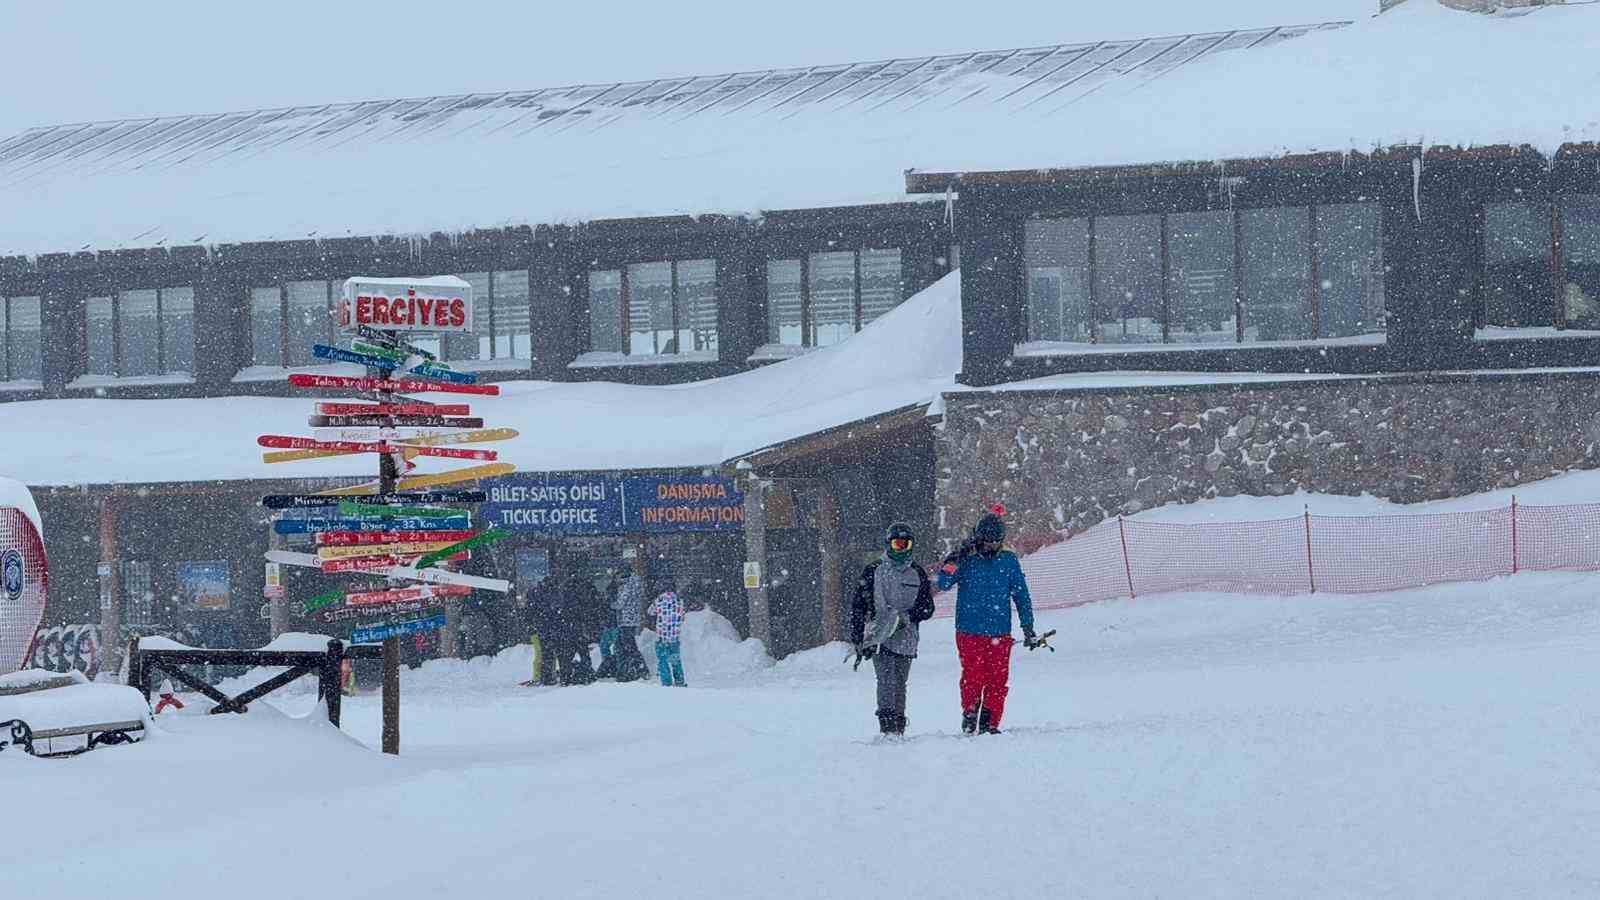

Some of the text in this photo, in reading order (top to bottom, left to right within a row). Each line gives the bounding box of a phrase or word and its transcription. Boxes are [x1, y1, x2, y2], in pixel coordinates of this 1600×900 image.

[356, 289, 466, 327] ERCİYES
[491, 481, 606, 503] BİLET SATIŞ OFİSİ
[656, 483, 727, 504] DANIŞMA
[401, 520, 417, 529] 32
[501, 507, 598, 525] TICKET OFFICE
[641, 506, 745, 524] INFORMATION
